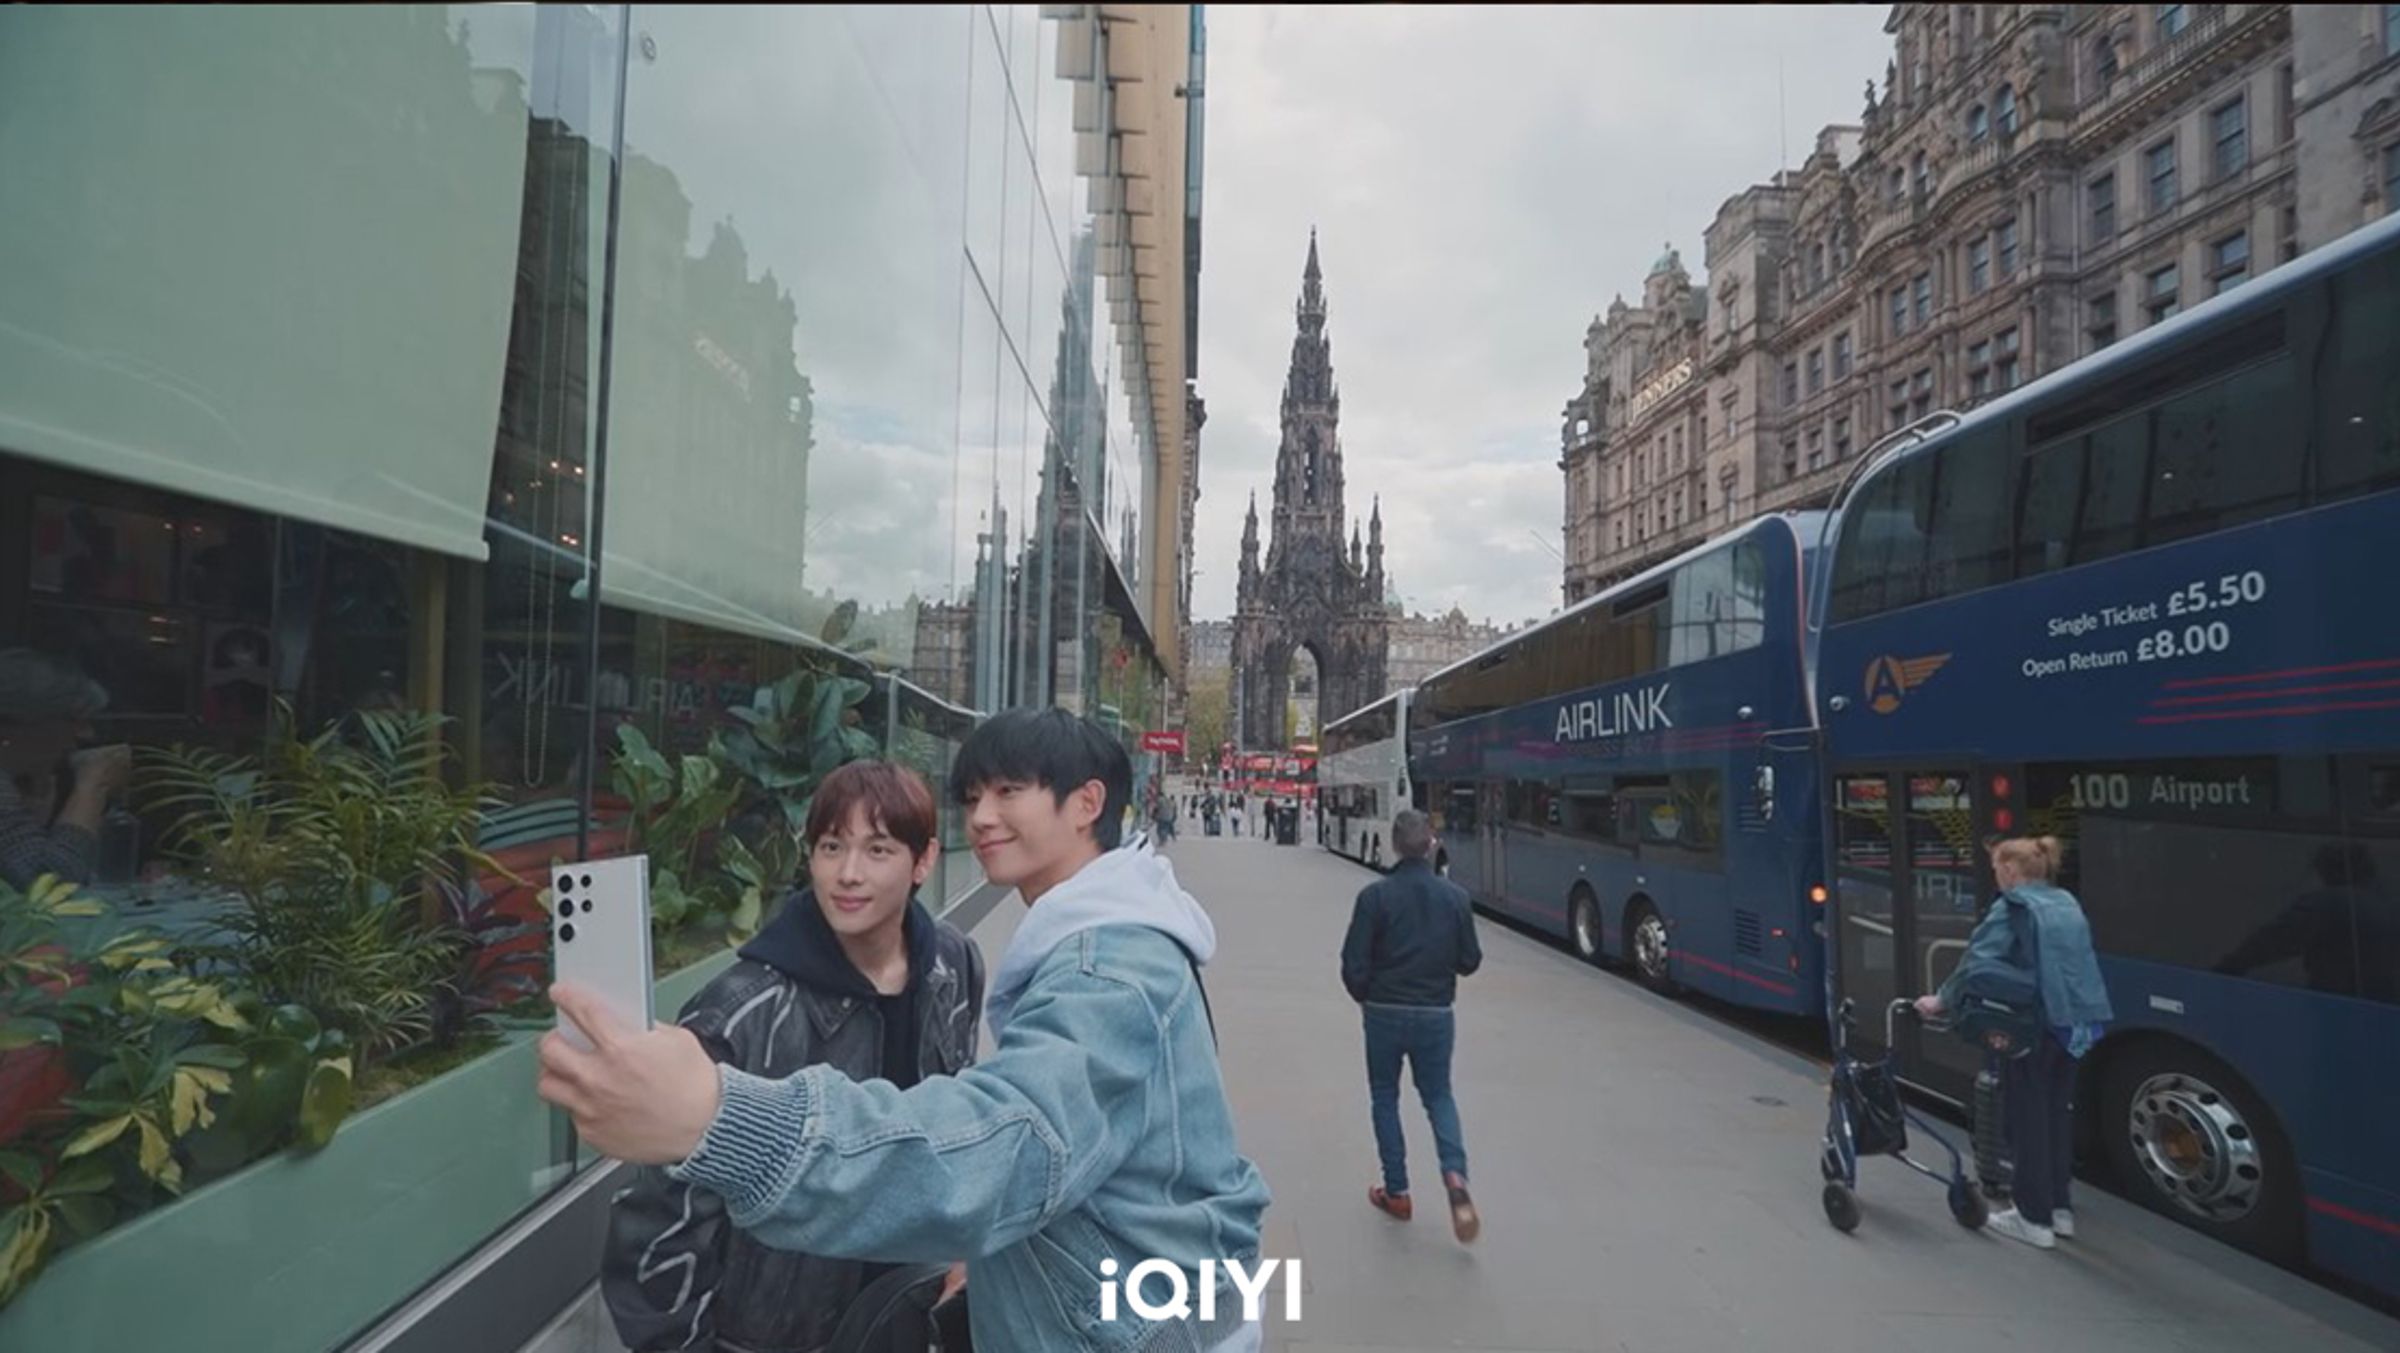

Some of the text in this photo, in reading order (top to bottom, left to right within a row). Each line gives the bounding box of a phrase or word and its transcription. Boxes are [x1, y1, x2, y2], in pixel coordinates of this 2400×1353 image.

[2048, 570, 2266, 637] Single Ticket £5.50
[2022, 621, 2230, 678] Open Return £8.00
[1555, 683, 1673, 742] AIRLINK
[2069, 773, 2250, 811] 100 Airport
